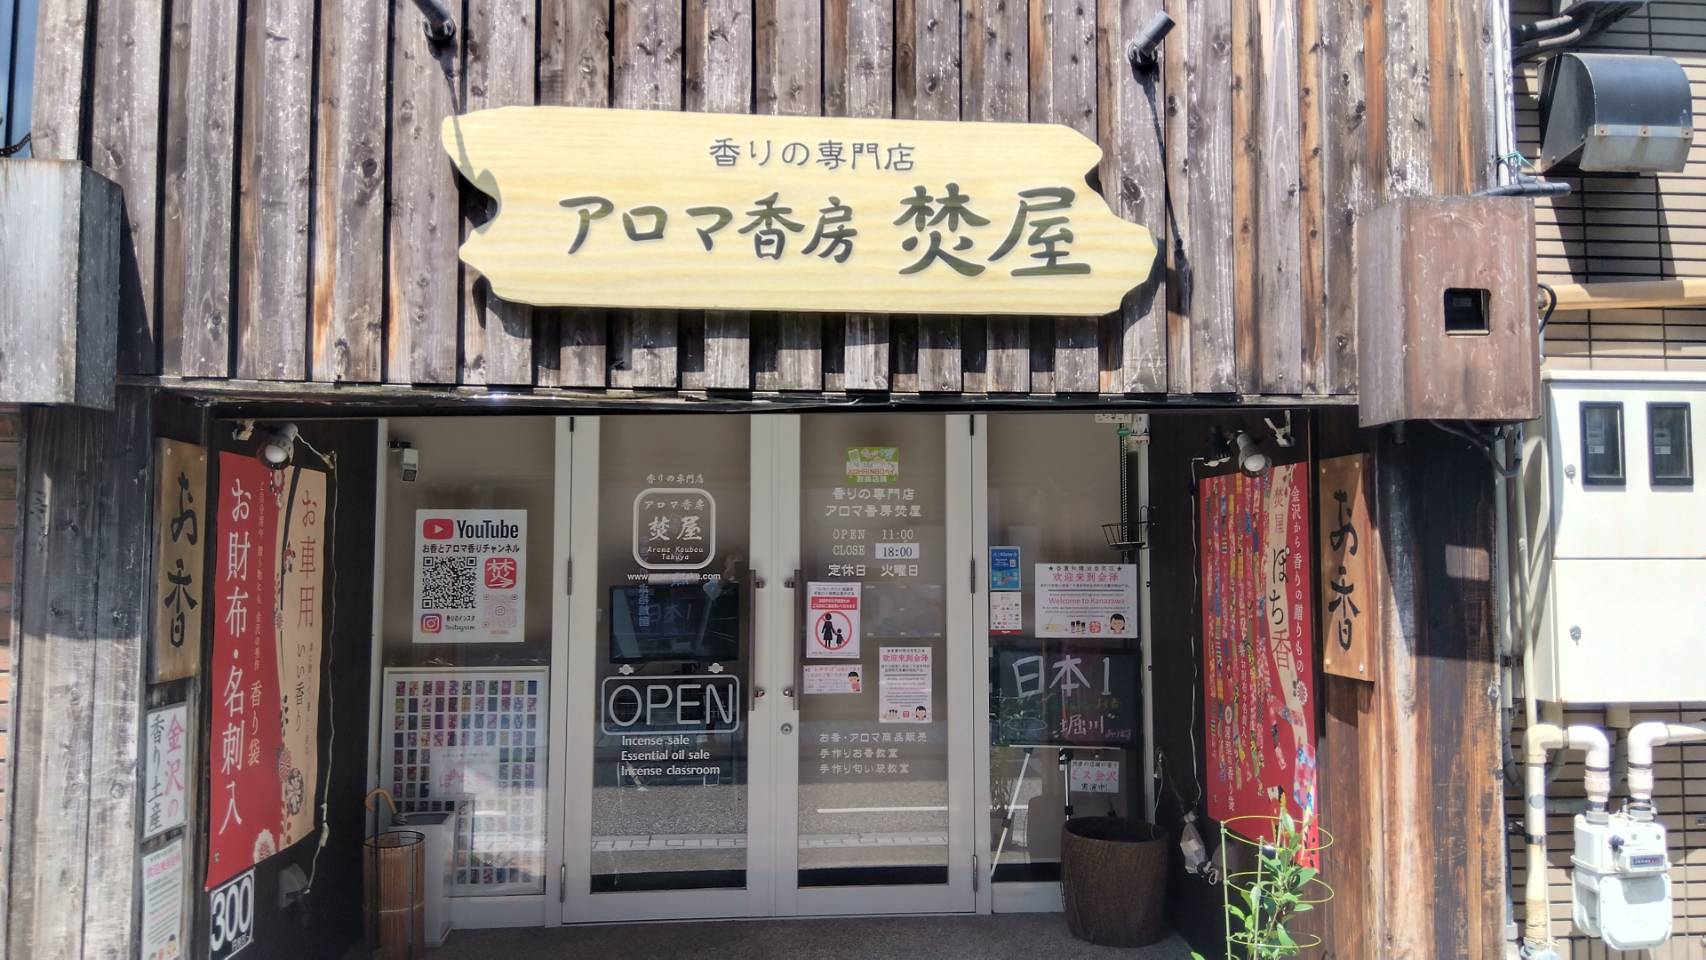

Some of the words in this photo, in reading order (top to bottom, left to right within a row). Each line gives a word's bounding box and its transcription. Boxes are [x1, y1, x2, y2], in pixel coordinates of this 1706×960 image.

[709, 138, 917, 172] 香りの専門店
[558, 192, 861, 264] アロマ香房
[894, 182, 1092, 278] 焚屋
[646, 473, 705, 485] 香りの専門店
[832, 487, 915, 501] 香りの専門店
[644, 498, 705, 511] アロマ香房
[825, 504, 922, 518] アロマ香房焚屋
[457, 519, 519, 539] YouTube
[648, 515, 703, 542] 焚屋
[832, 528, 867, 541] OPEN
[882, 528, 914, 541] 11:00
[422, 543, 520, 554] お香とアロマ香りチャンネル
[832, 544, 866, 556] CLOSE
[883, 546, 913, 558] 18:00
[164, 471, 198, 648] お香
[297, 490, 317, 630] お車用
[828, 563, 866, 577] 定休日
[880, 563, 918, 577] 火曜日
[1290, 487, 1305, 673] 金沢から香りの贈りもの
[1328, 490, 1360, 652] お香
[1048, 597, 1081, 605] Welcome
[1082, 597, 1090, 605] to
[1090, 597, 1125, 605] Kanazawa
[1269, 546, 1293, 672] ぽち香
[218, 478, 252, 836] お財布・名刺入
[609, 683, 734, 727] OPEN
[247, 680, 264, 767] 香り袋
[622, 736, 663, 746] Incense
[668, 735, 690, 745] sale
[819, 732, 928, 743] お香・アロマ商品販売
[164, 713, 185, 817] 金沢の
[621, 750, 669, 761] Essential
[672, 749, 685, 760] oil
[688, 749, 711, 760] sale
[621, 766, 663, 776] Incense
[666, 765, 721, 775] classroom
[210, 876, 252, 952] 300
